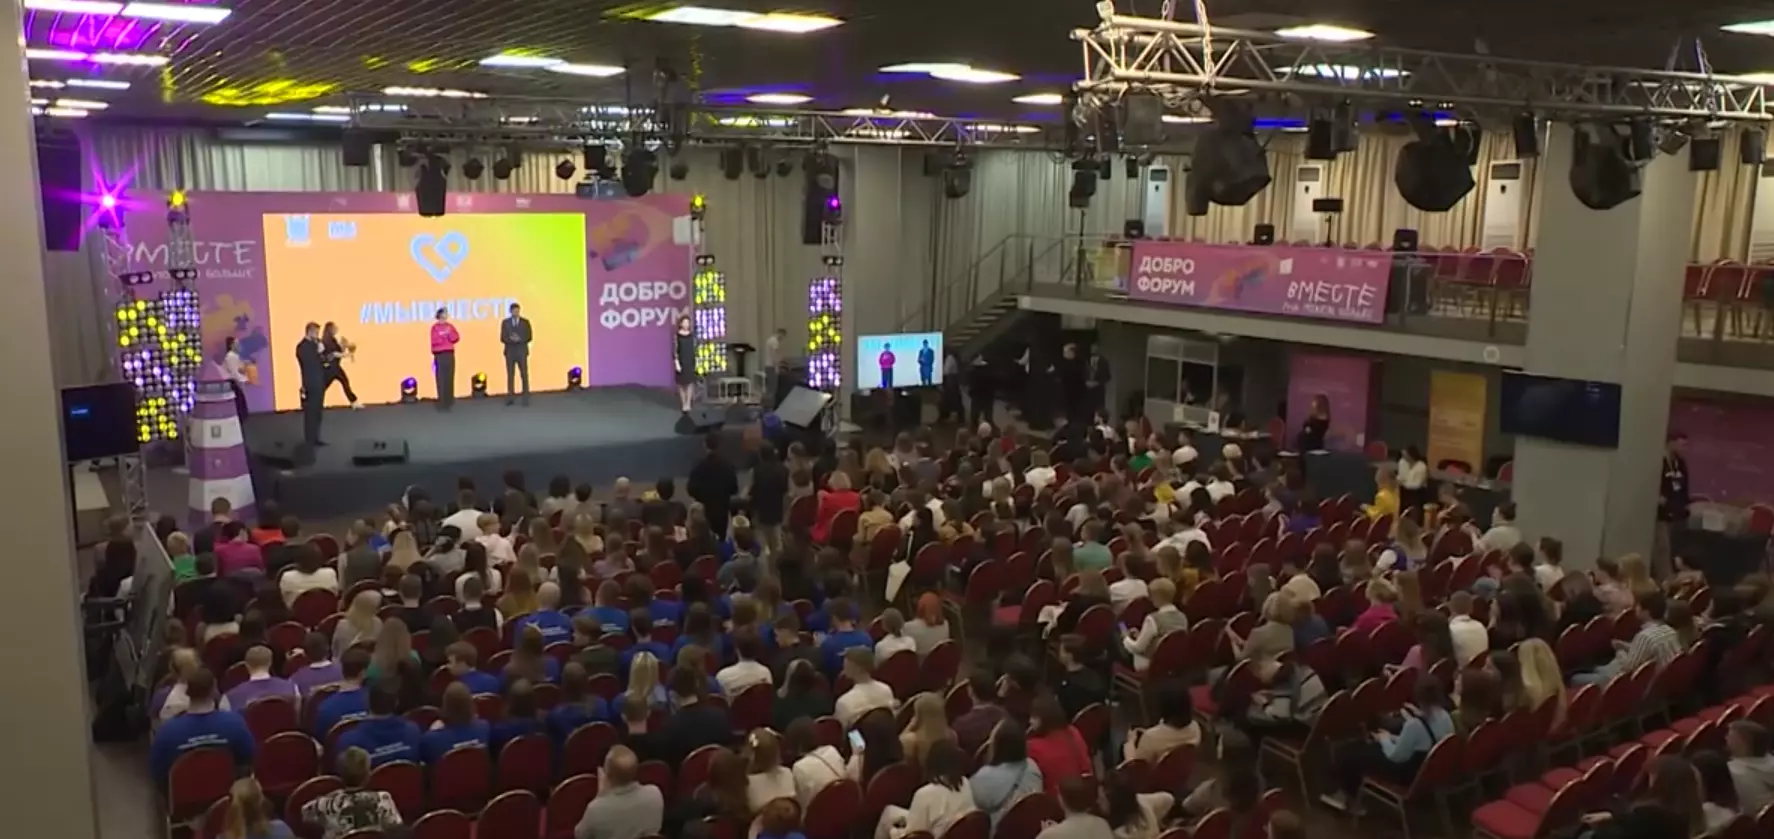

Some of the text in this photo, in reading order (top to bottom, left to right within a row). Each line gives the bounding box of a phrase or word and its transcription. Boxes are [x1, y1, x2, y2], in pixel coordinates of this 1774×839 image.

[118, 240, 256, 265] МСТЕ
[1138, 256, 1195, 275] ДОБРО
[599, 281, 687, 306] ДОБРО
[1137, 275, 1195, 297] ФОРУМ
[1287, 280, 1377, 310] ВМЕСТЕ
